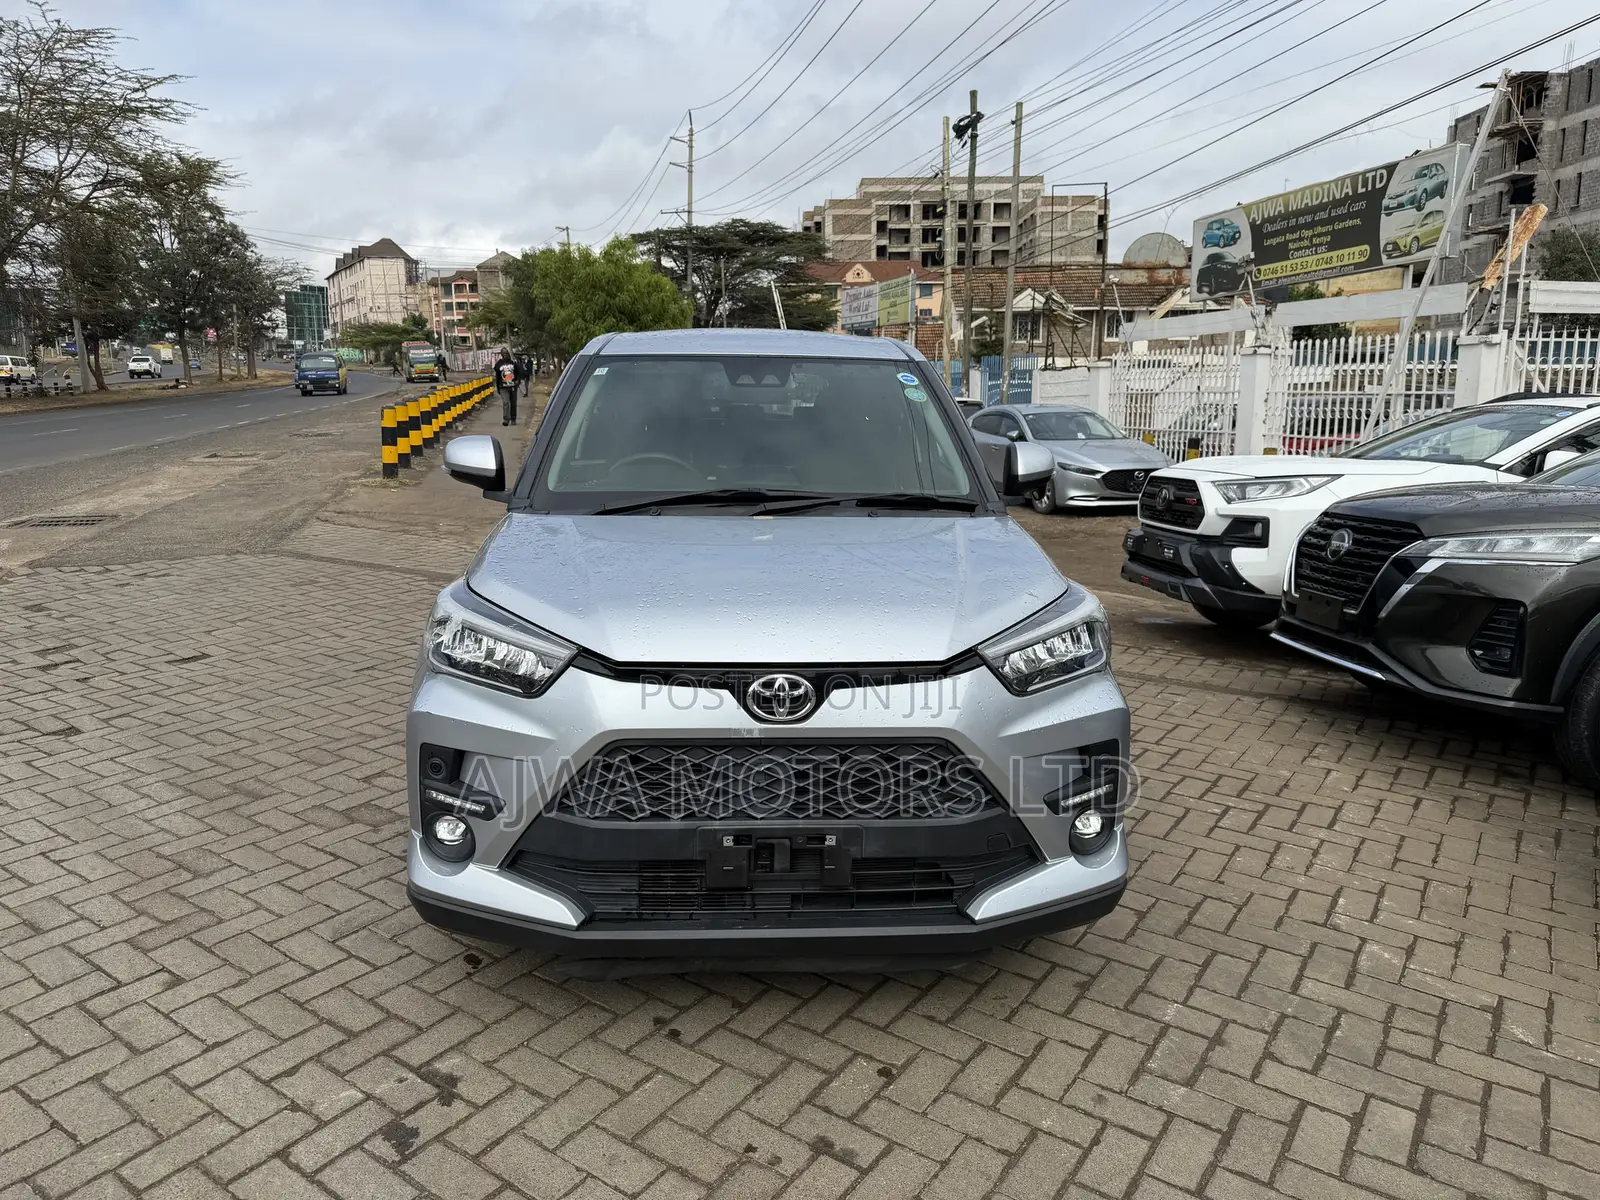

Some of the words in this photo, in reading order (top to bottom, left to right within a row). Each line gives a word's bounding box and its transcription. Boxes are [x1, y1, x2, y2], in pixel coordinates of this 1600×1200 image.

[1249, 197, 1284, 225] AJWA
[1289, 178, 1352, 211] MADINA
[1358, 168, 1388, 194] LTD
[1262, 218, 1288, 233] Dealers
[1289, 216, 1297, 227] in
[1297, 213, 1314, 224] new
[1314, 205, 1331, 220] and
[1331, 200, 1351, 216] used
[1350, 200, 1367, 212] cars
[1263, 235, 1285, 246] Langata
[1286, 230, 1300, 241] Road
[1312, 235, 1331, 245] Kenya
[1262, 266, 1279, 277] 0746
[1280, 264, 1288, 274] 51
[1290, 262, 1299, 272] 53
[1300, 260, 1309, 270] 53
[1315, 255, 1333, 267] 0748
[1336, 253, 1345, 263] 10
[1347, 251, 1356, 261] 11
[1358, 248, 1368, 260] 90
[1289, 247, 1316, 259] Contact
